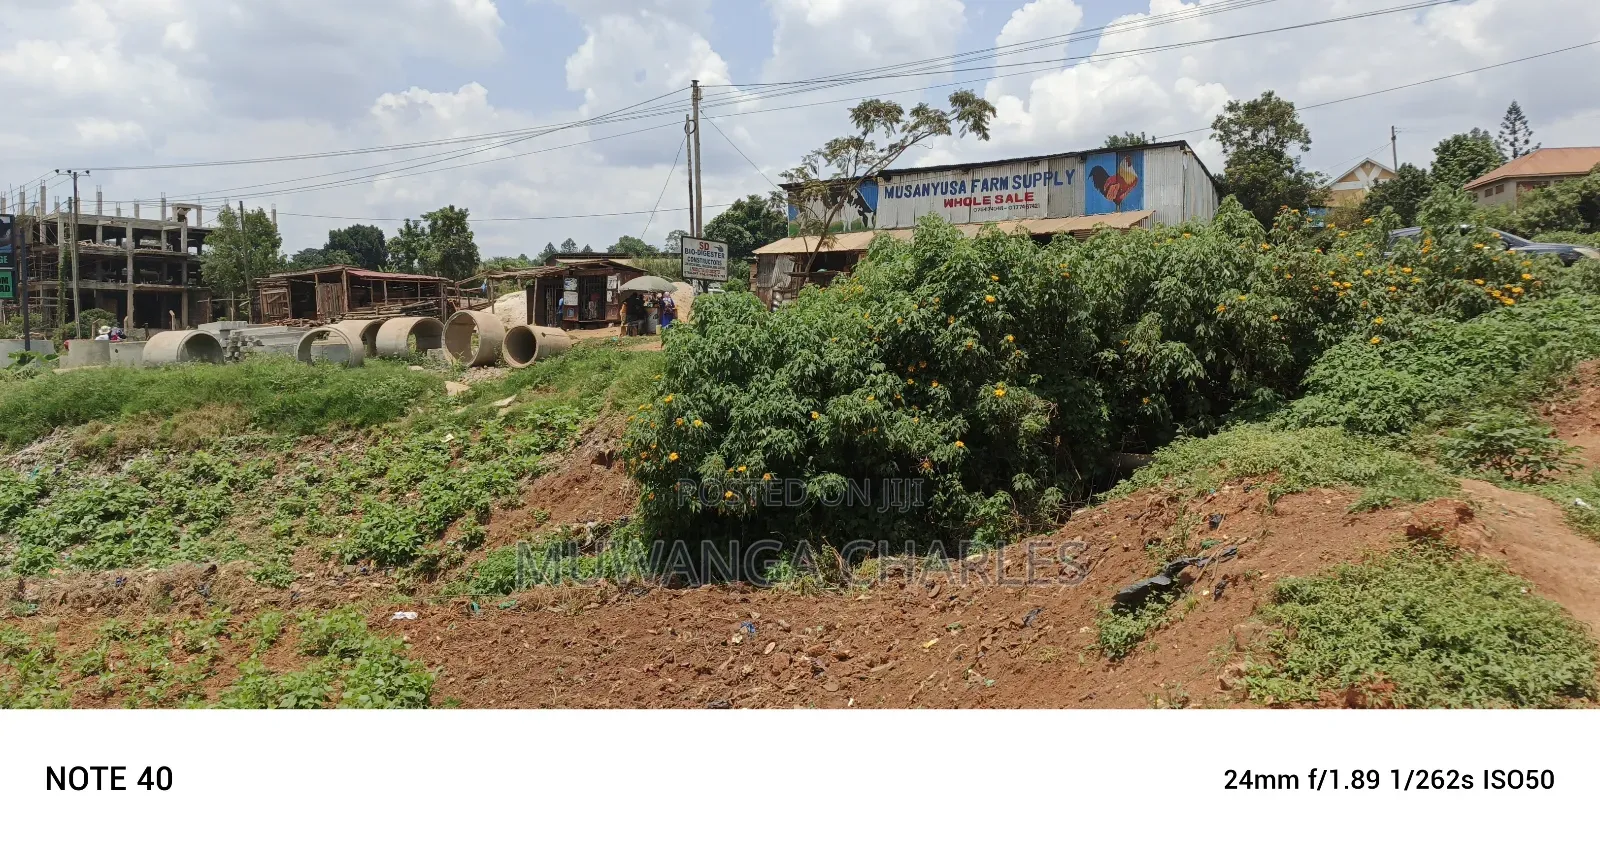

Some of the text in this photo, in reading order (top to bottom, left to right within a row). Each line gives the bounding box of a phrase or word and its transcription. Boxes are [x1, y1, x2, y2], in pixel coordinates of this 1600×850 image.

[884, 169, 1075, 199] MUSANYUSA FARM SUPPLY
[699, 241, 710, 251] SD
[684, 247, 726, 259] BIO-DIGESTER
